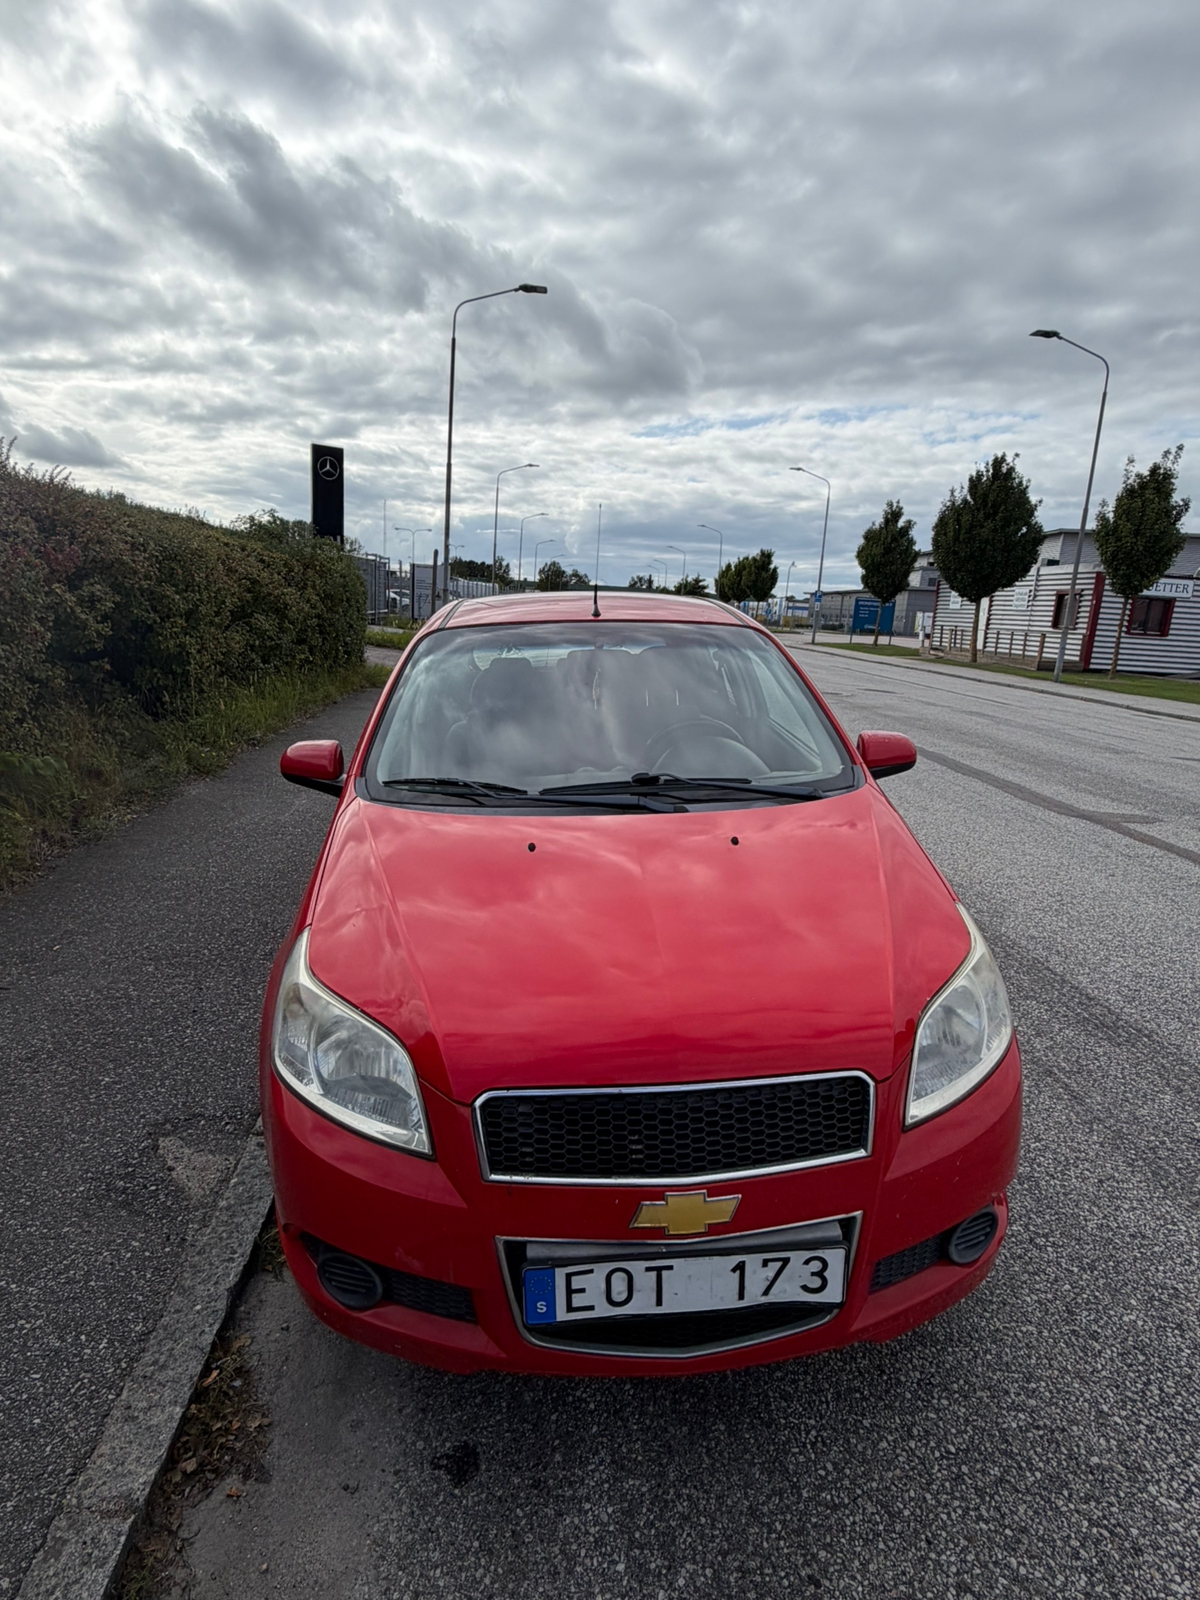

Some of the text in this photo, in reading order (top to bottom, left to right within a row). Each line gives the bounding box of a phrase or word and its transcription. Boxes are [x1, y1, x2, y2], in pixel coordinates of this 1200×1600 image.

[565, 1255, 830, 1314] EOT 173
[536, 1301, 547, 1314] S
